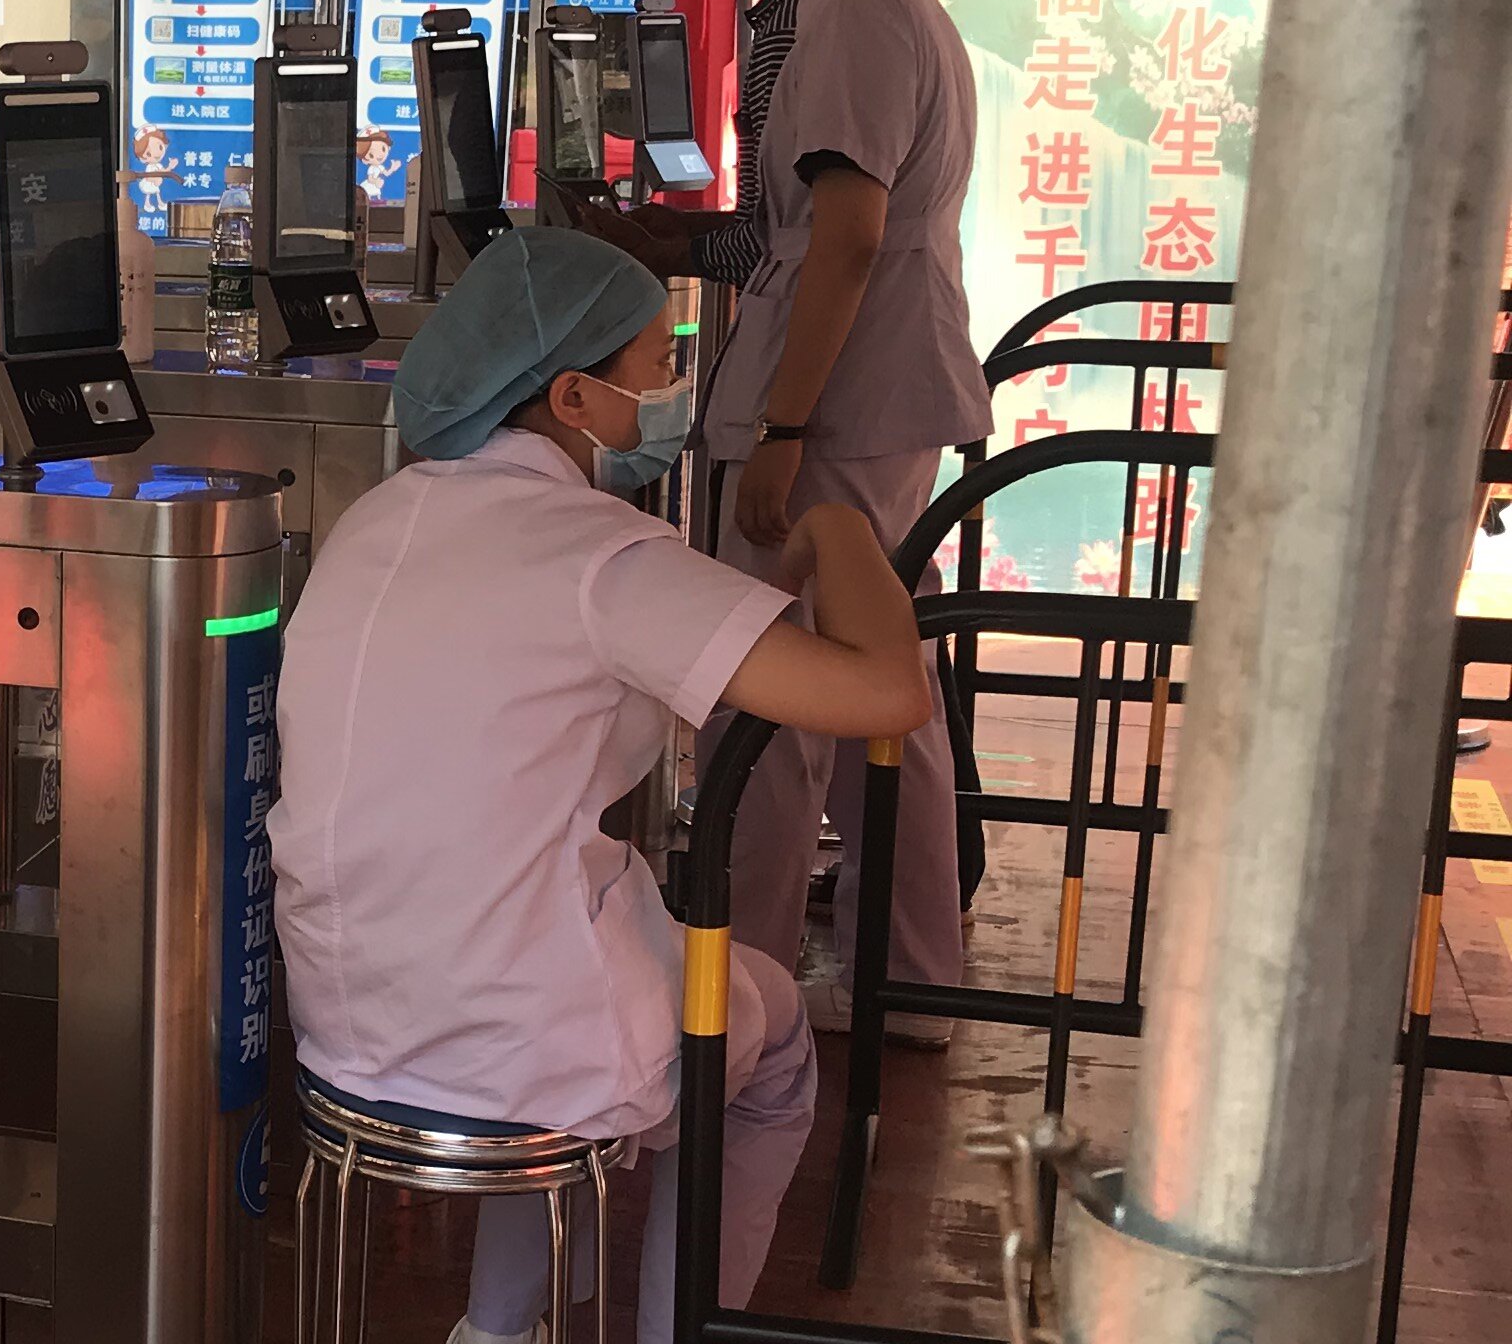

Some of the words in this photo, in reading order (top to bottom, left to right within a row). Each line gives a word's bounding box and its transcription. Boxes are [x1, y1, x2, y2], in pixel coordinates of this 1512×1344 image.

[186, 25, 241, 38] 扫健康码
[191, 61, 246, 74] 测量体温
[171, 104, 231, 119] 进入院区
[138, 216, 166, 231] 您的
